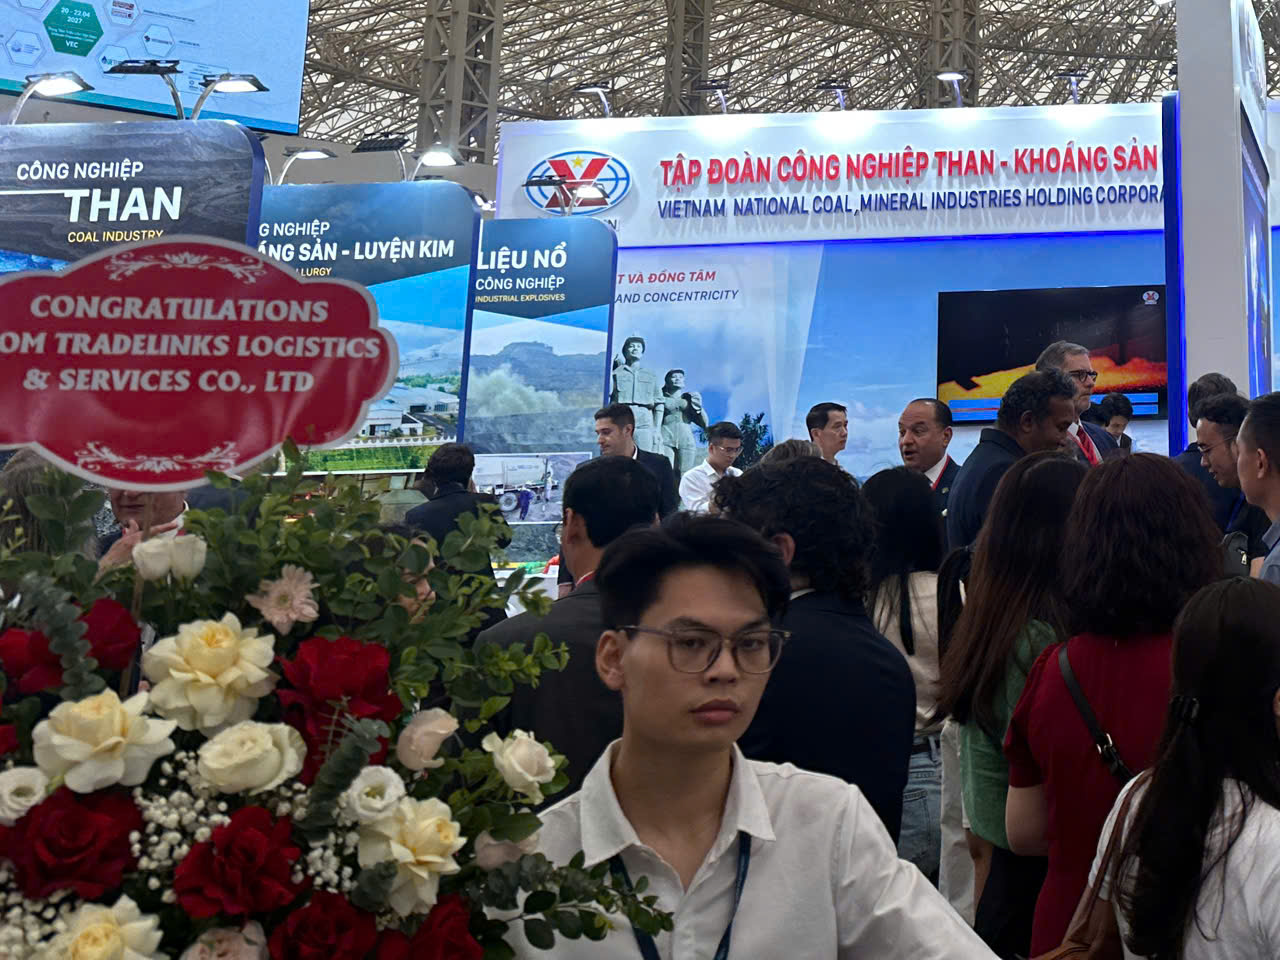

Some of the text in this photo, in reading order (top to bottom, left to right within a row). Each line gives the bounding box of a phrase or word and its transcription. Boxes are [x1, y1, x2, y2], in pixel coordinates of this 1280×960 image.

[67, 16, 83, 24] 2027
[65, 40, 79, 49] VEC
[16, 158, 144, 182] CÔNG NGHIỆP
[660, 153, 702, 193] TẬP
[707, 151, 772, 185] ĐOÀN
[777, 149, 841, 182] CÔNG
[846, 145, 929, 185] NGHIỆP
[934, 150, 995, 177] THAN
[1014, 140, 1108, 174] KHOÁNG
[1113, 137, 1158, 171] SẢN
[64, 186, 183, 223] THAN
[658, 199, 726, 218] VIETNAM
[734, 195, 809, 217] NATIONAL
[931, 189, 1021, 209] INDUSTRIES
[1026, 186, 1093, 206] HOLDING
[67, 229, 164, 243] COAL INDUSTRY
[273, 219, 330, 238] NGHIỆP
[298, 238, 338, 262] SẢN
[354, 236, 414, 263] LUYỆN
[419, 239, 455, 259] KIM
[476, 241, 568, 274] LIỆU NỔ
[475, 274, 565, 291] CÔNG NGHIỆP
[628, 270, 643, 284] VÀ
[648, 269, 686, 283] ĐỒNG
[689, 268, 716, 281] TÂM
[30, 294, 329, 323] CONGRATULATIONS
[475, 293, 565, 303] INDUSTRIAL EXPLOSIVES
[614, 289, 739, 304] AND CONCENTRICITY
[55, 332, 230, 357] TRADELINKS
[236, 336, 381, 359] LOGISTICS
[23, 368, 314, 394] & SERVICES CO., LTD
